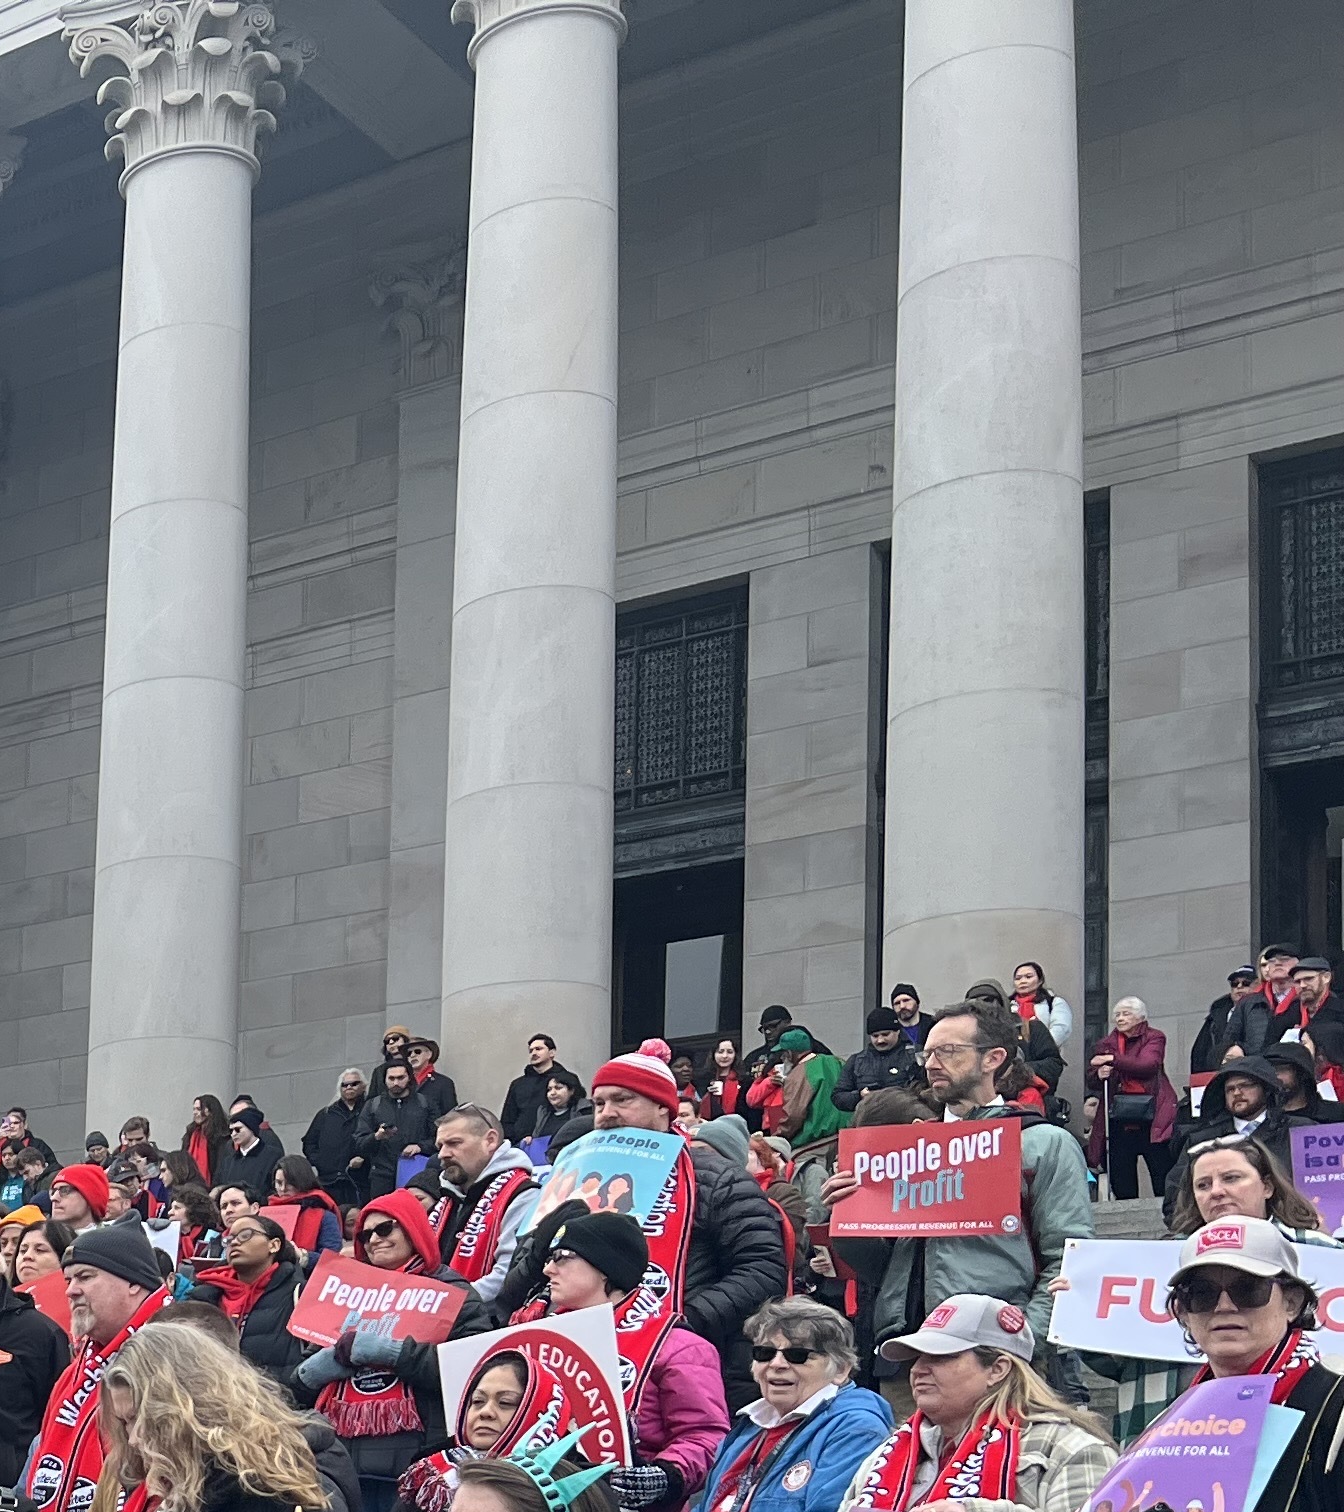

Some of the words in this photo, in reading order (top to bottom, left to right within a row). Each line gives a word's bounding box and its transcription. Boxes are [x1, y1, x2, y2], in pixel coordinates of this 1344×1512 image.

[607, 1134, 660, 1149] People
[854, 1138, 941, 1186] People
[948, 1126, 1004, 1166] over
[891, 1168, 964, 1213] Profit
[960, 1221, 977, 1229] FOR
[978, 1220, 994, 1229] ALL
[318, 1275, 393, 1315] People
[395, 1288, 450, 1314] over
[1160, 1414, 1246, 1437] choice
[1183, 1445, 1206, 1456] FOR
[1208, 1445, 1230, 1456] ALL
